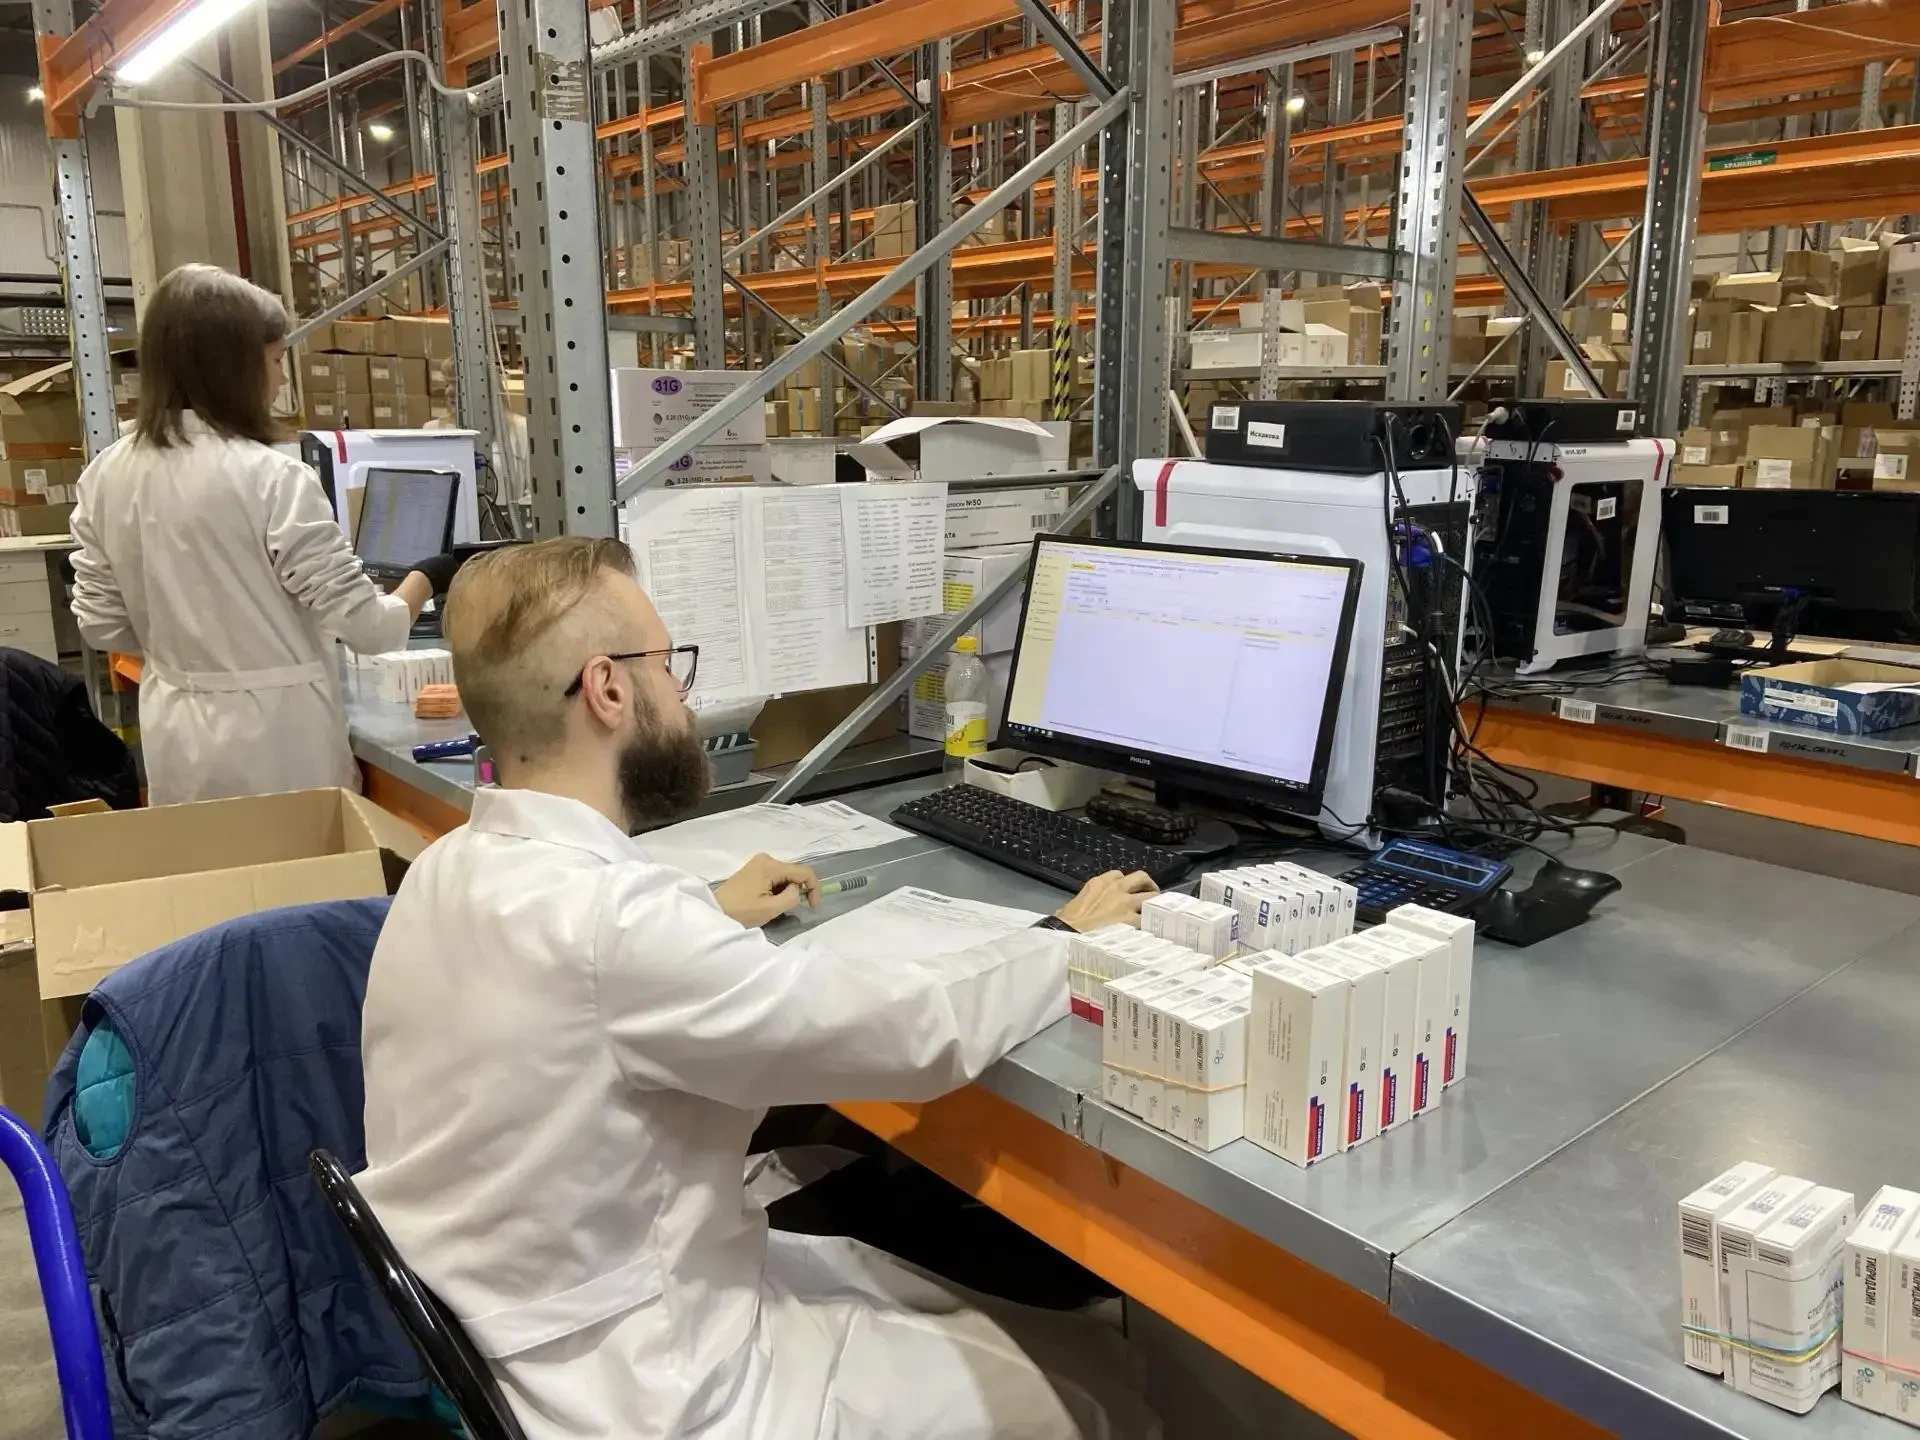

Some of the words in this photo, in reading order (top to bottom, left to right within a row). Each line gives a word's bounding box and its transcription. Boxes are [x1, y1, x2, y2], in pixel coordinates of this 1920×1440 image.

[655, 380, 679, 392] 31G
[669, 456, 690, 468] 1G
[1865, 1257, 1877, 1306] ТИОРИДАЗИН
